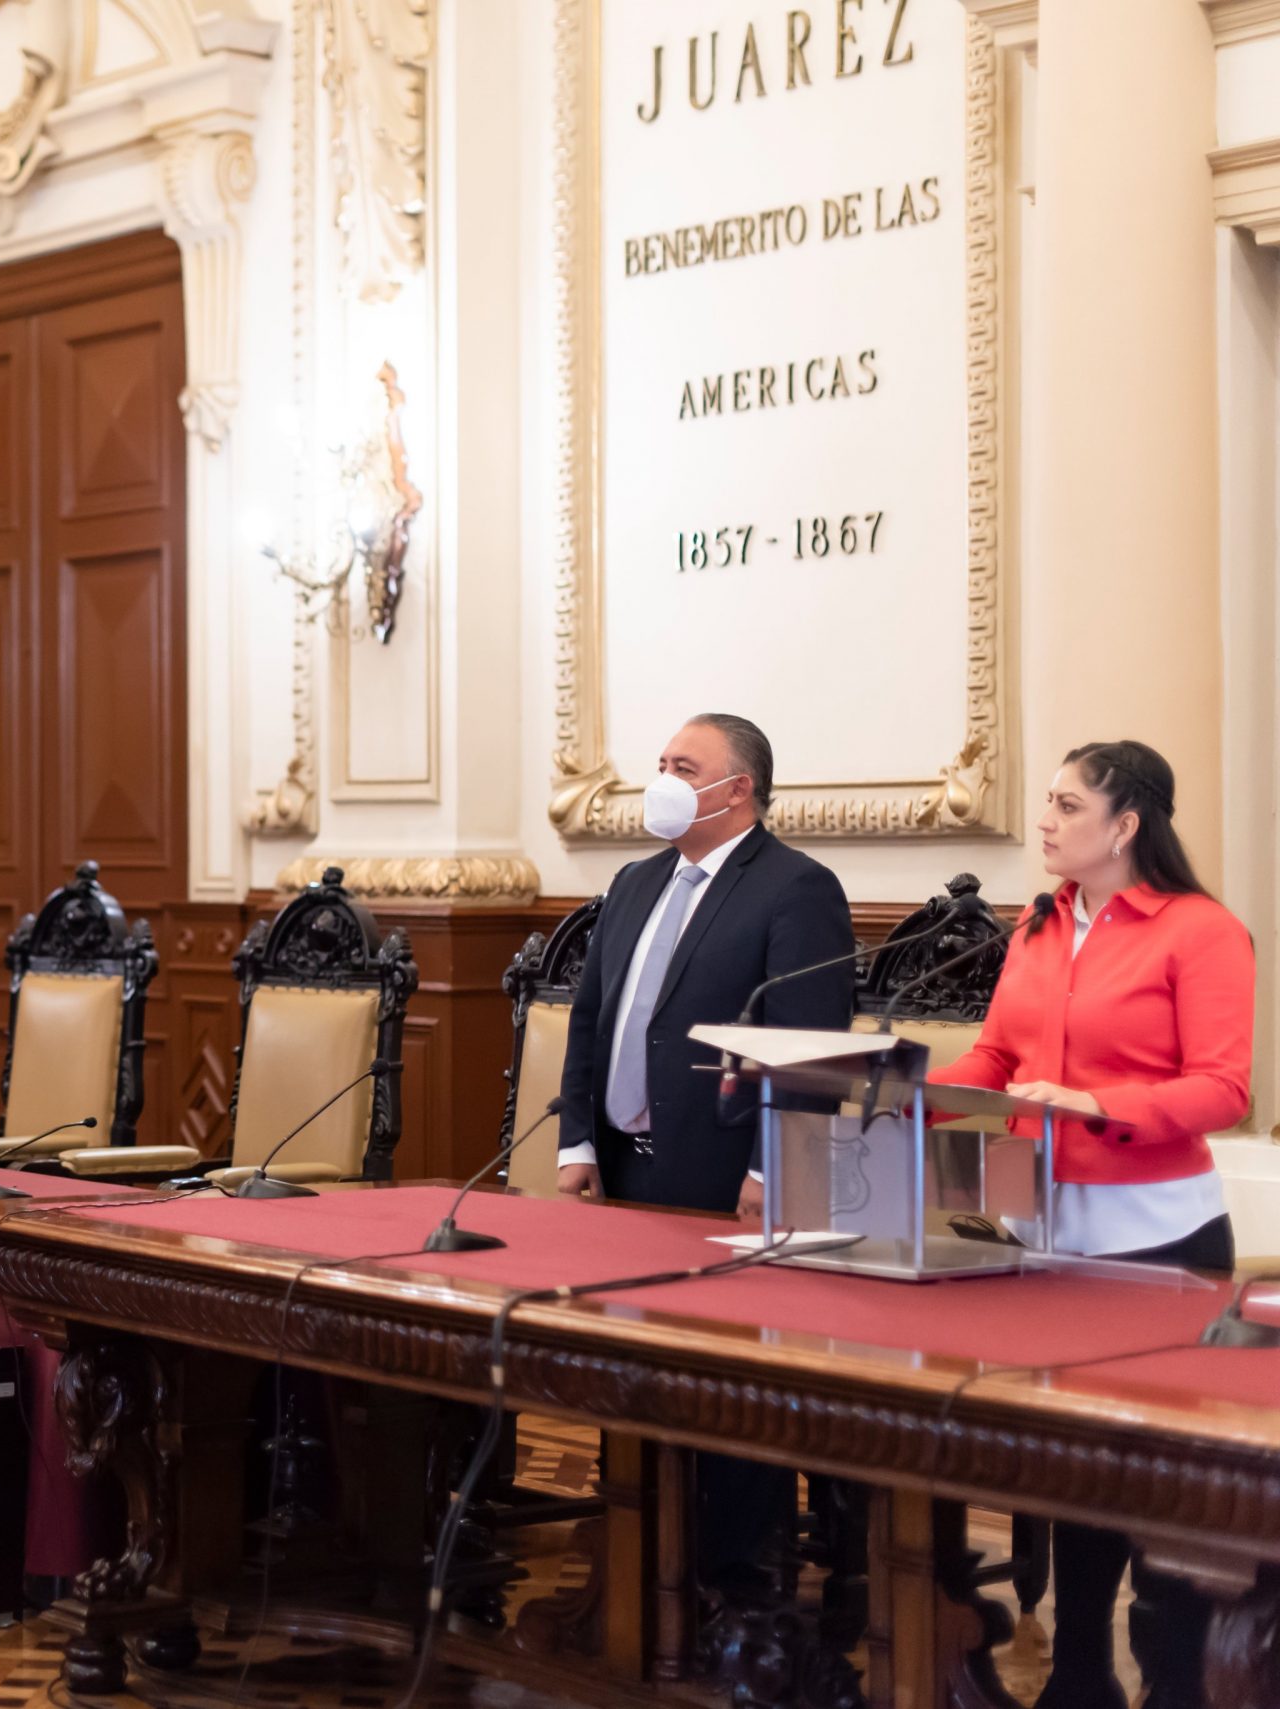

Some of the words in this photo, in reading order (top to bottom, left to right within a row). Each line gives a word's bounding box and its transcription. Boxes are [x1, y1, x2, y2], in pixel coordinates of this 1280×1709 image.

[637, 0, 915, 124] JUAREZ
[624, 204, 808, 278] BENEMERITO
[822, 192, 863, 241] DE
[875, 176, 941, 232] LAS
[678, 349, 879, 421] AMERICAS
[677, 524, 755, 573] 1857
[794, 510, 884, 561] 1867
